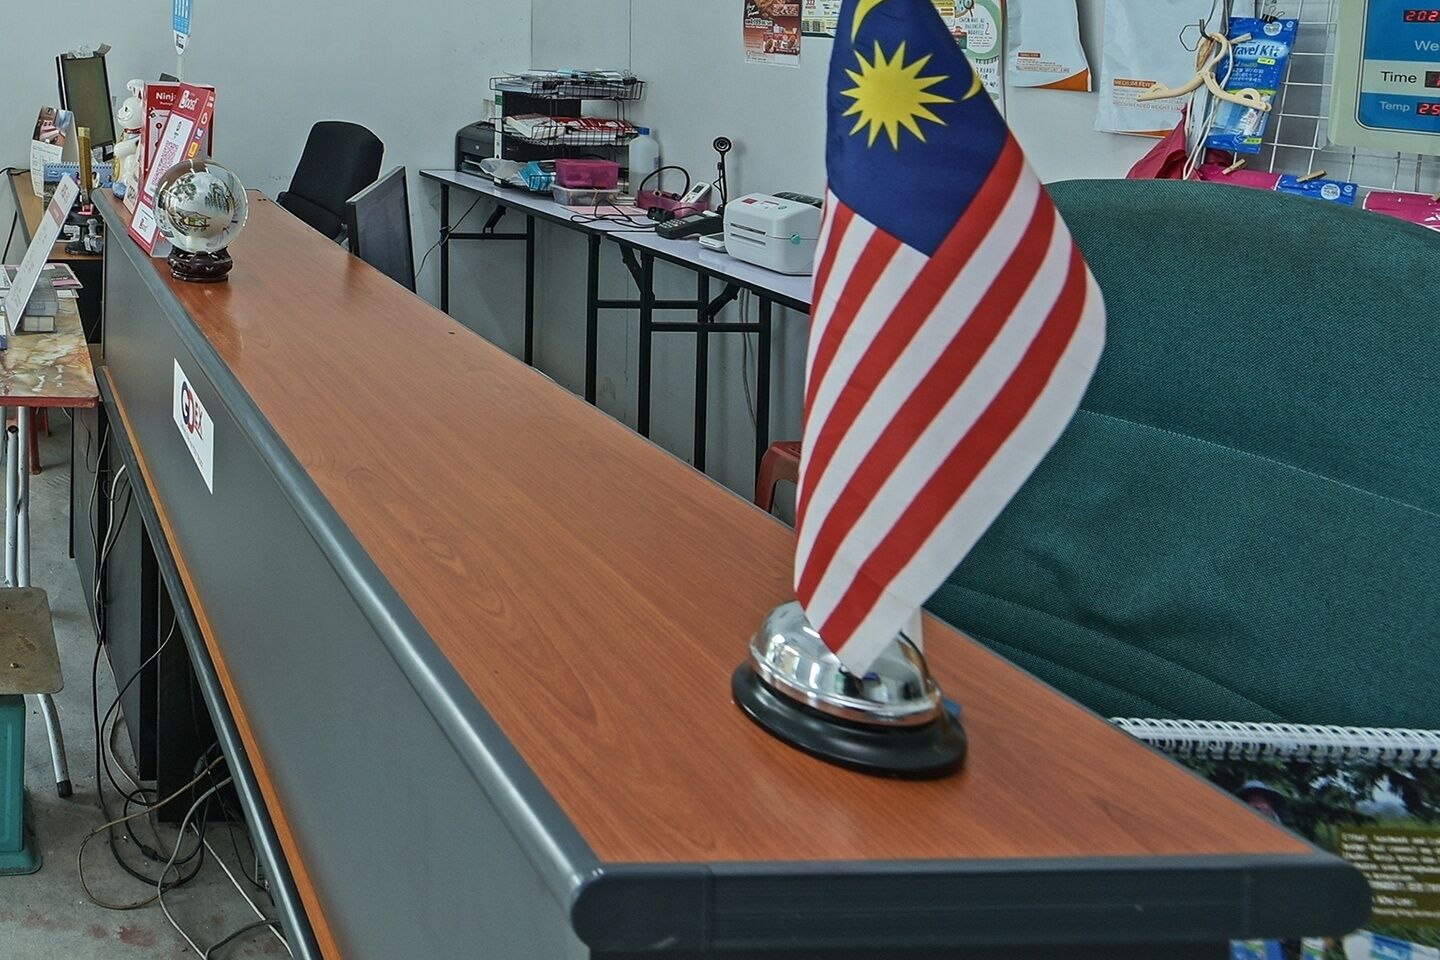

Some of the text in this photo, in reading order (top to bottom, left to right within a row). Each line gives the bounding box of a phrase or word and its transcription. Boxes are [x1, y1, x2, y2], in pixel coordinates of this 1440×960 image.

[1259, 45, 1281, 57] Kit
[1380, 71, 1417, 84] Time
[155, 92, 177, 102] Ninj
[1379, 101, 1410, 113] Temp
